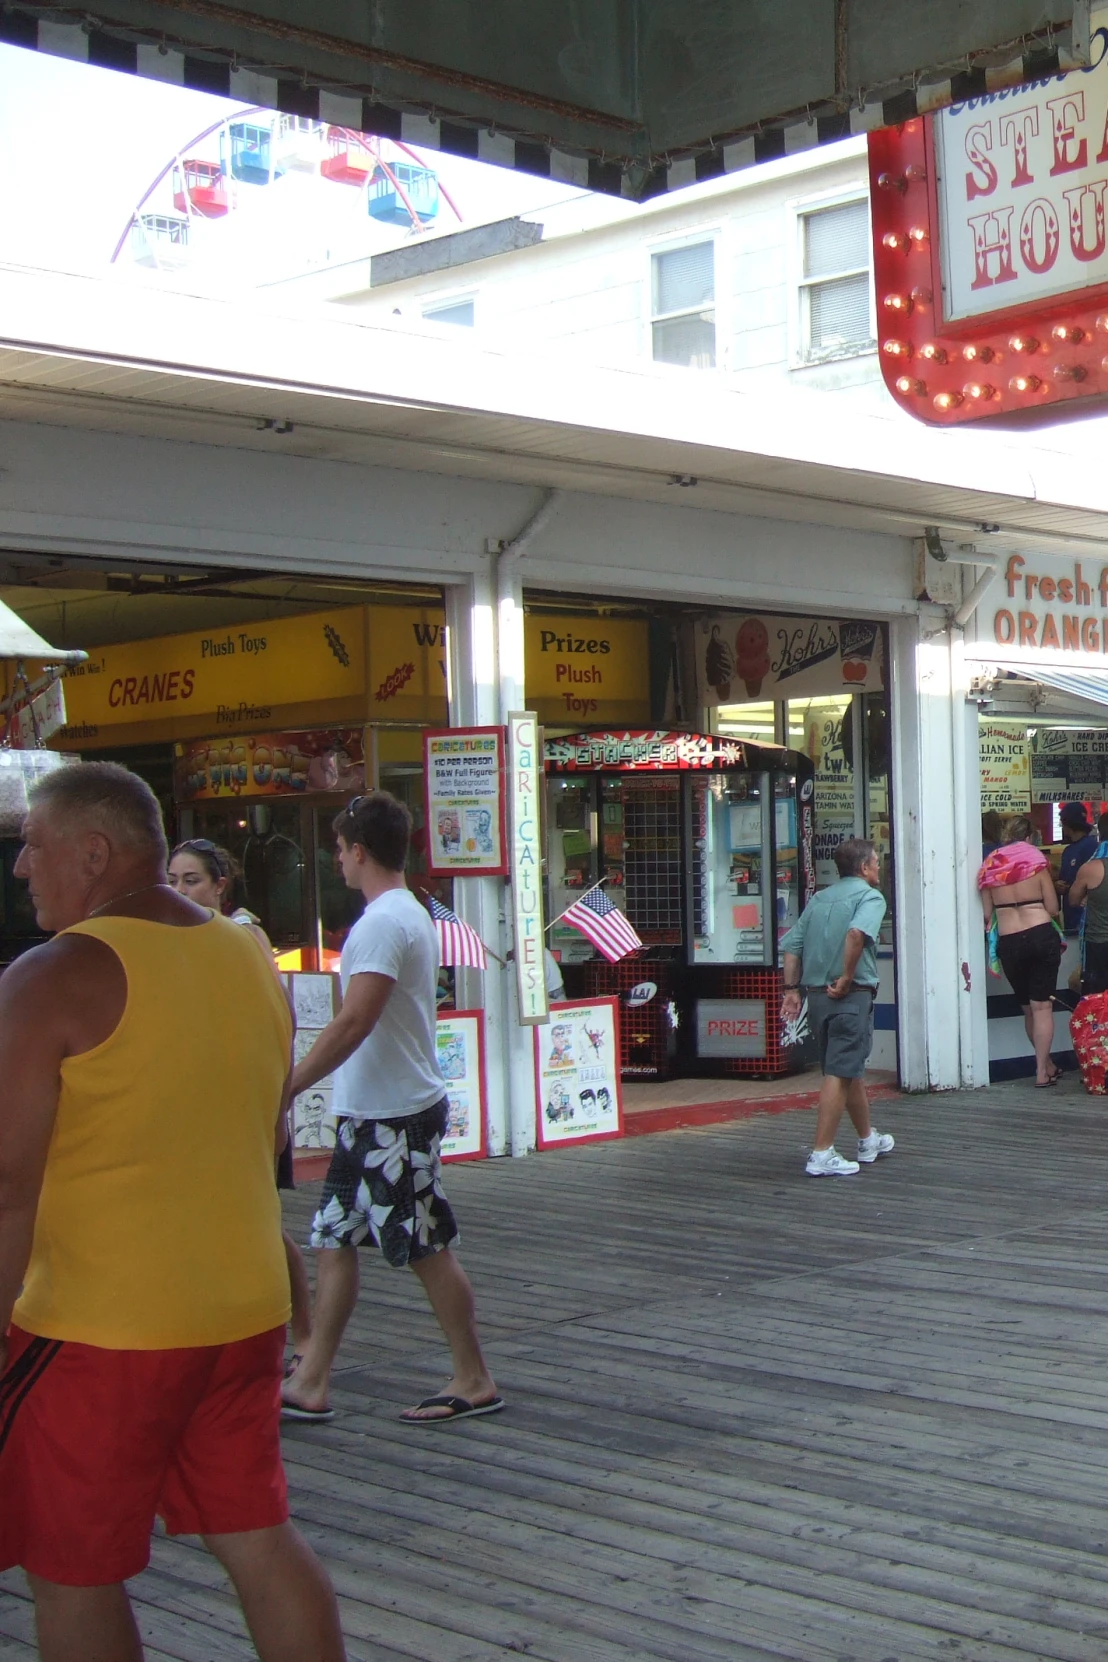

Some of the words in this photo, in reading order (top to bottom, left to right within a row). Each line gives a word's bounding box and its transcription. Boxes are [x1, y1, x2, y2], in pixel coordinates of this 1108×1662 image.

[1006, 554, 1092, 607] fresh
[413, 623, 447, 647] Wi
[201, 636, 235, 658] Plush
[239, 633, 267, 652] Toys
[540, 630, 611, 655] Prizes
[771, 622, 838, 672] Kohr's
[555, 664, 602, 684] Plush
[108, 669, 196, 708] CRANES
[562, 692, 598, 717] Toys
[216, 704, 237, 724] Big
[238, 702, 272, 721] Prizes
[1077, 732, 1094, 740] HAND
[1009, 745, 1024, 755] ICE
[1072, 742, 1088, 752] ICE
[436, 769, 453, 778] B&W
[455, 768, 468, 777] Full
[469, 768, 494, 778] Figure
[454, 778, 490, 788] Background
[816, 792, 847, 801] ARIZONA
[1038, 791, 1085, 801] MILKSHAKES
[815, 801, 839, 811] TAMIN
[822, 819, 855, 835] Squeezed
[815, 833, 845, 846] ONADE
[632, 987, 651, 1000] LAI
[707, 1020, 759, 1037] PRIZE
[620, 1066, 658, 1074] games.com
